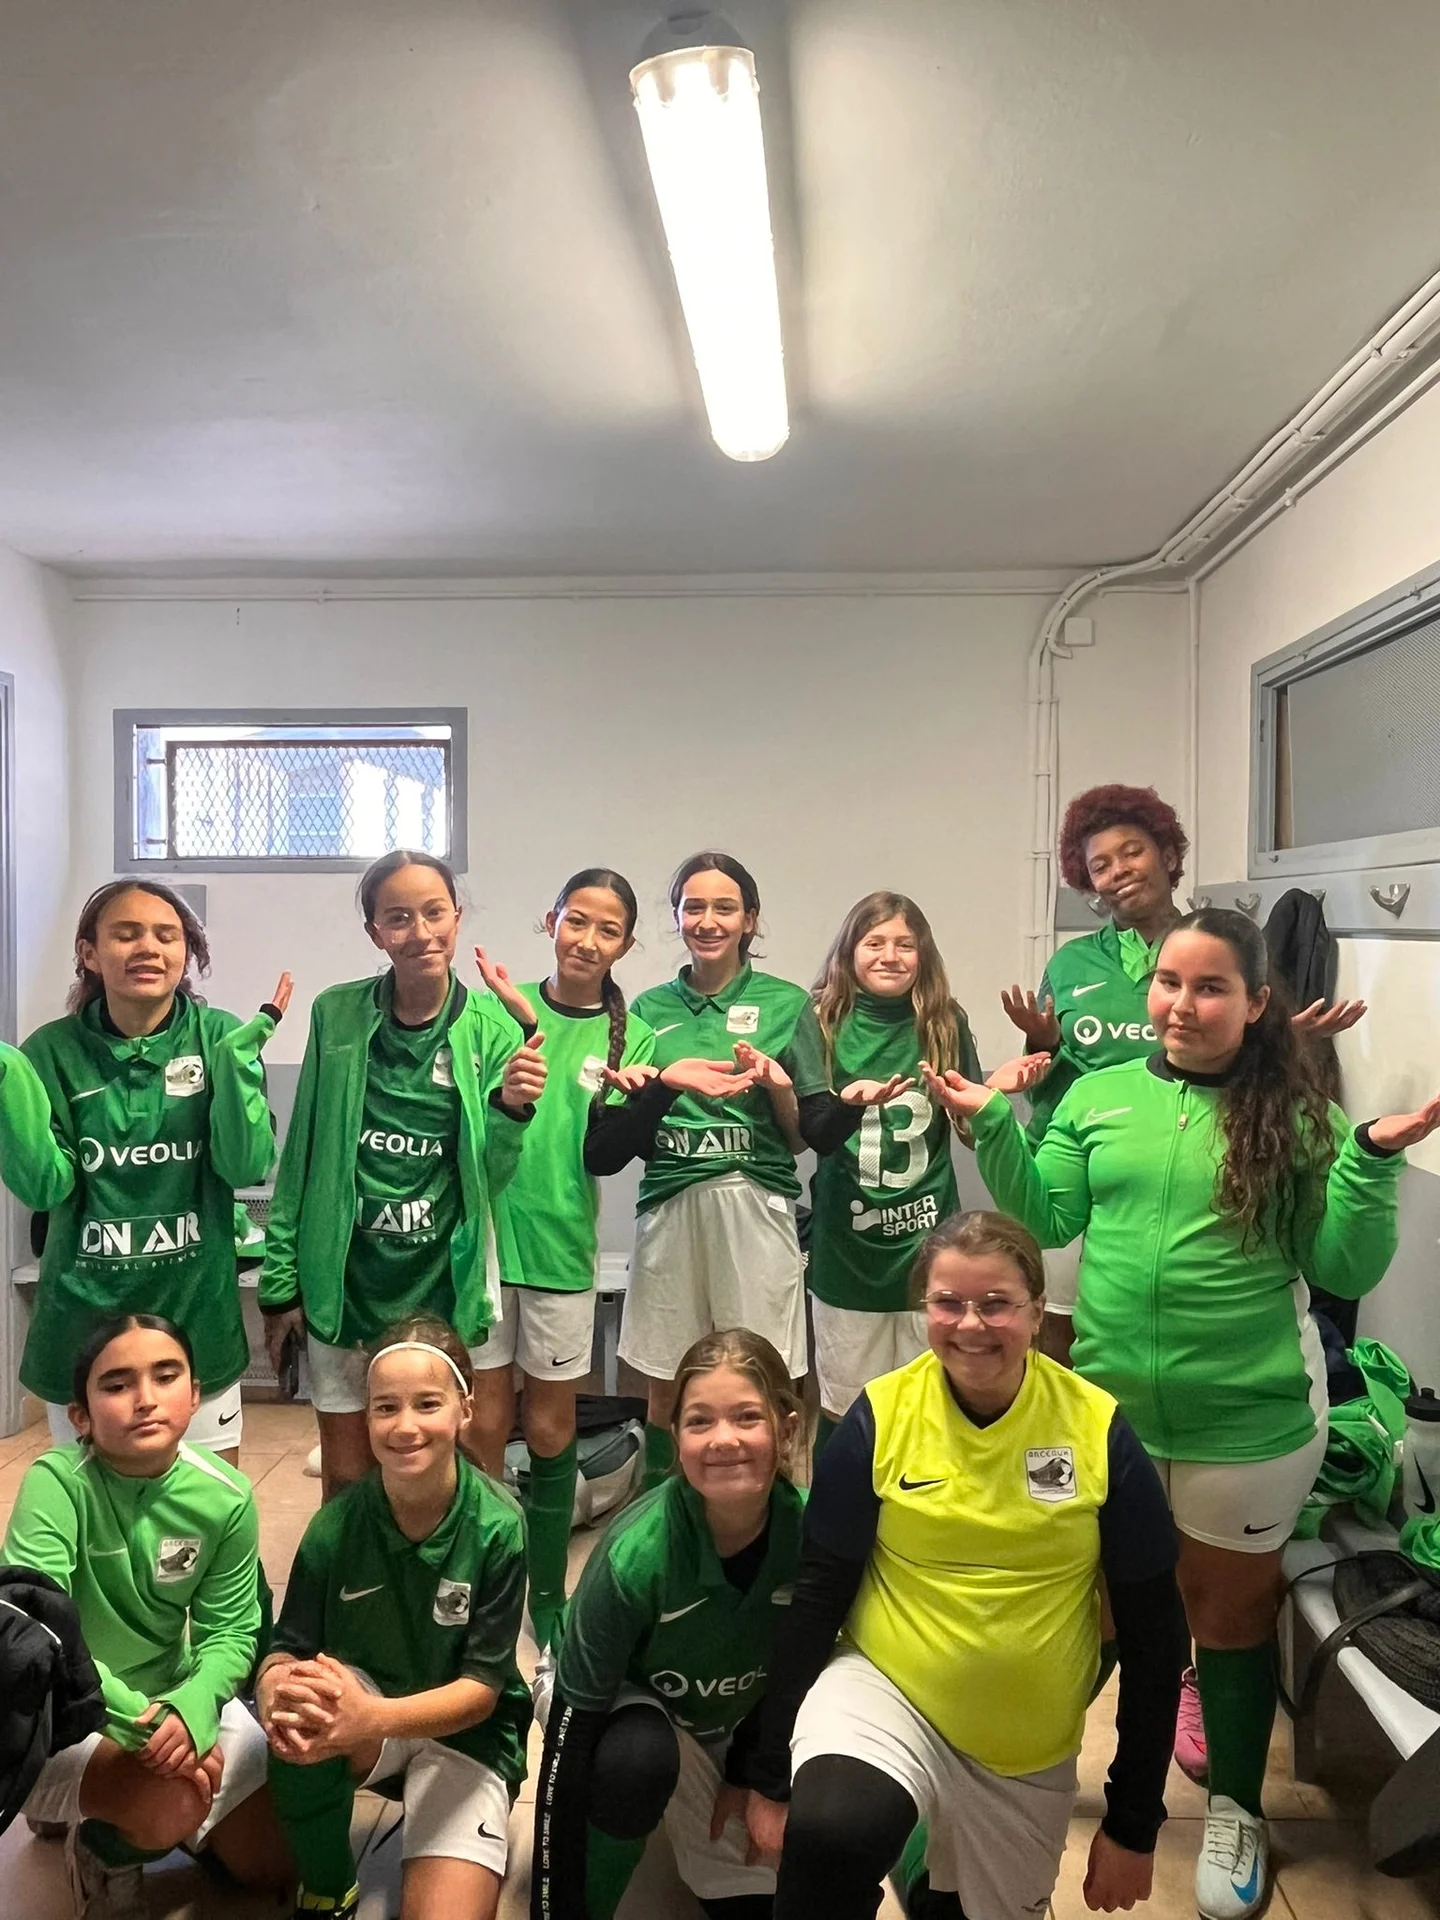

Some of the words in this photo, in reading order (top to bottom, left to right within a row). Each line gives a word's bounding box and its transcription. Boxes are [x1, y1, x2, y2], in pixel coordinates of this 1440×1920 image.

[696, 1128, 751, 1154] AIR
[858, 1091, 933, 1188] 13
[371, 1199, 432, 1233] AIR
[881, 1195, 937, 1225] INTER
[883, 1211, 940, 1237] SPORT
[82, 1221, 132, 1256] ON
[141, 1211, 201, 1254] AIR
